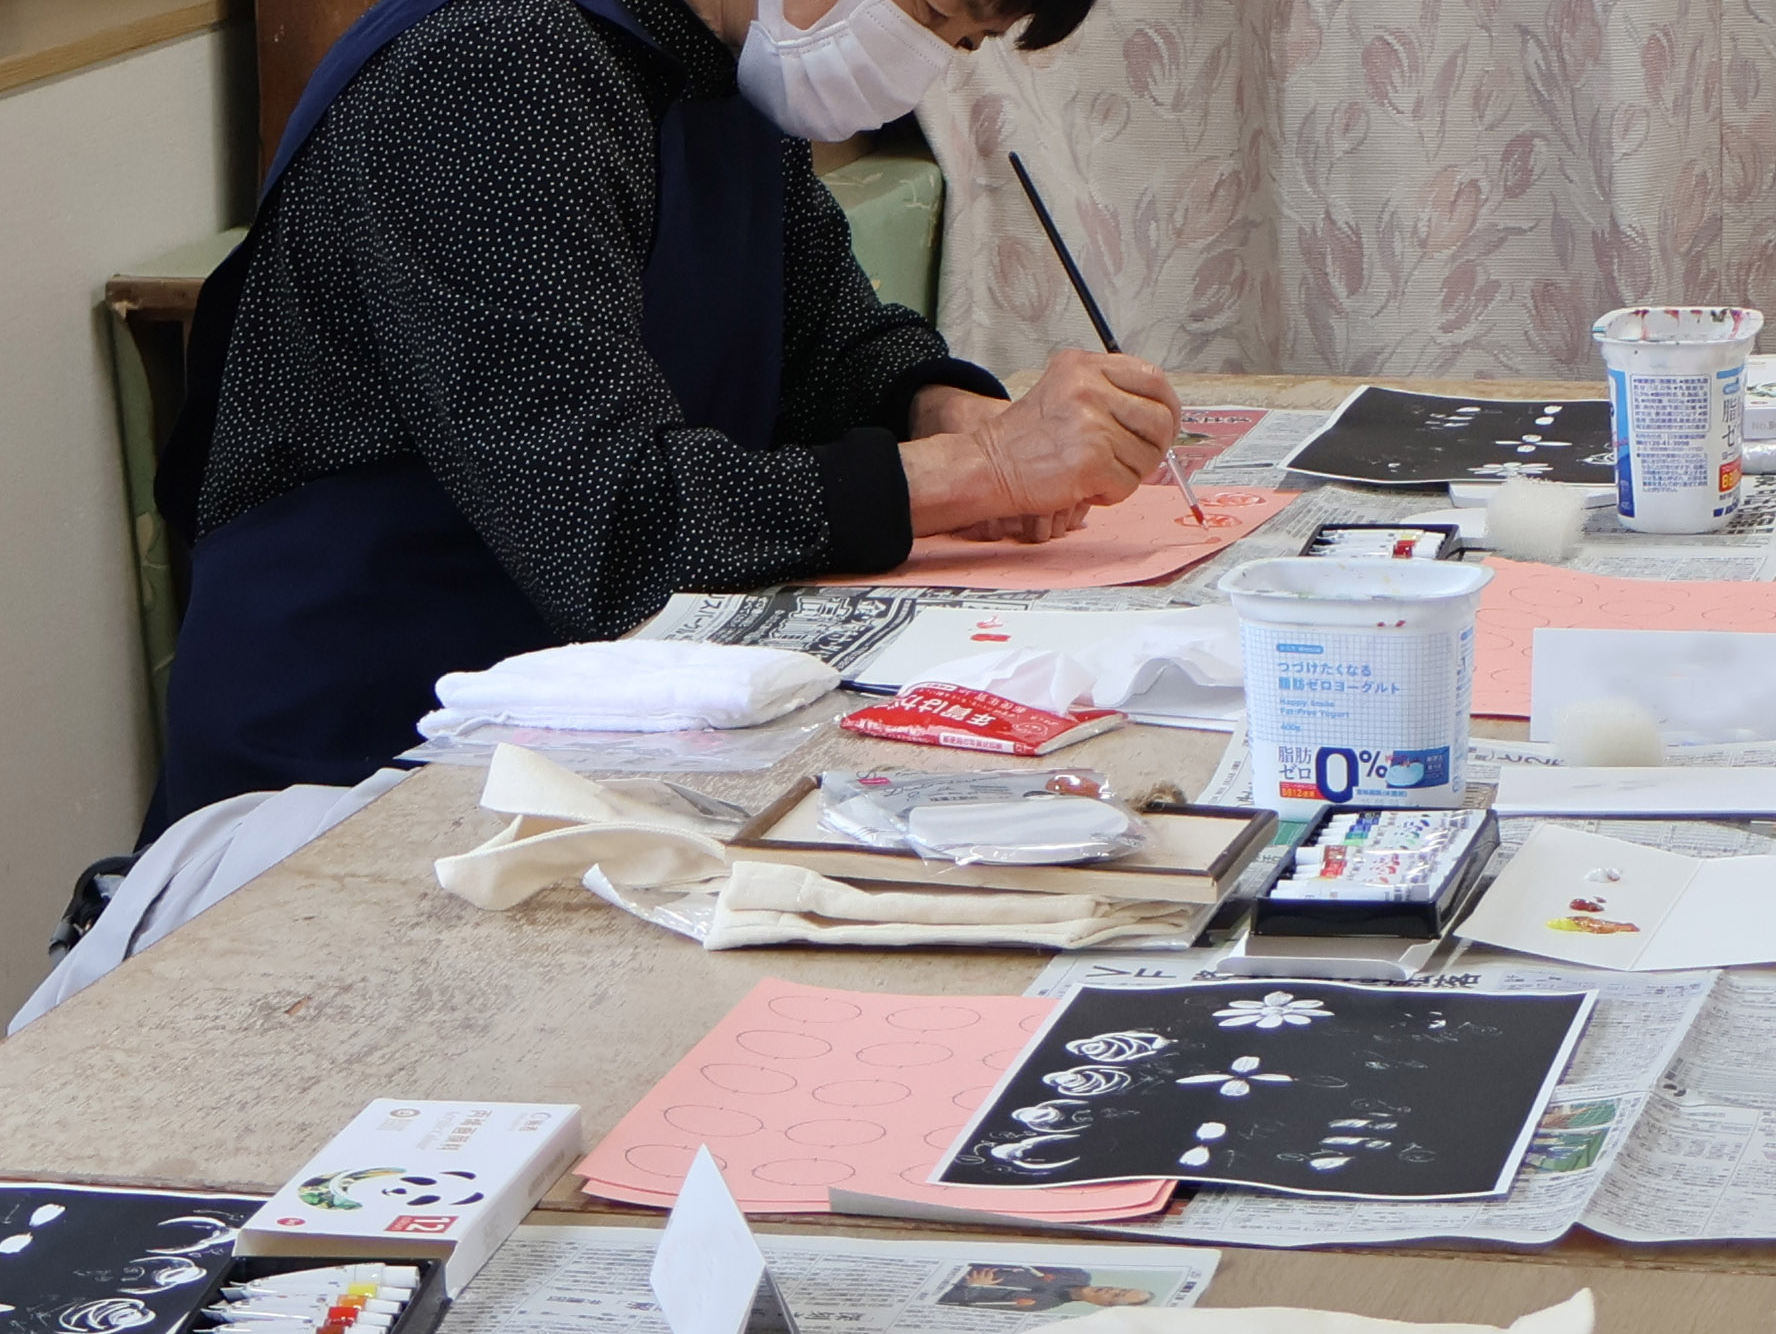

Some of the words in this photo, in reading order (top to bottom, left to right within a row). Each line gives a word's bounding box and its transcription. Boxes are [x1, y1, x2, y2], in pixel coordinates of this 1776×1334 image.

[1277, 661, 1372, 677] つづけたくなる
[1278, 676, 1400, 694] 脂肪ゼロヨーグルト
[1280, 698, 1308, 709] Happy
[1319, 709, 1349, 719] Yogurt
[1278, 746, 1312, 763] 脂肪
[1278, 764, 1312, 780] ゼロ
[1315, 746, 1388, 803] 0%
[406, 1216, 452, 1233] 12
